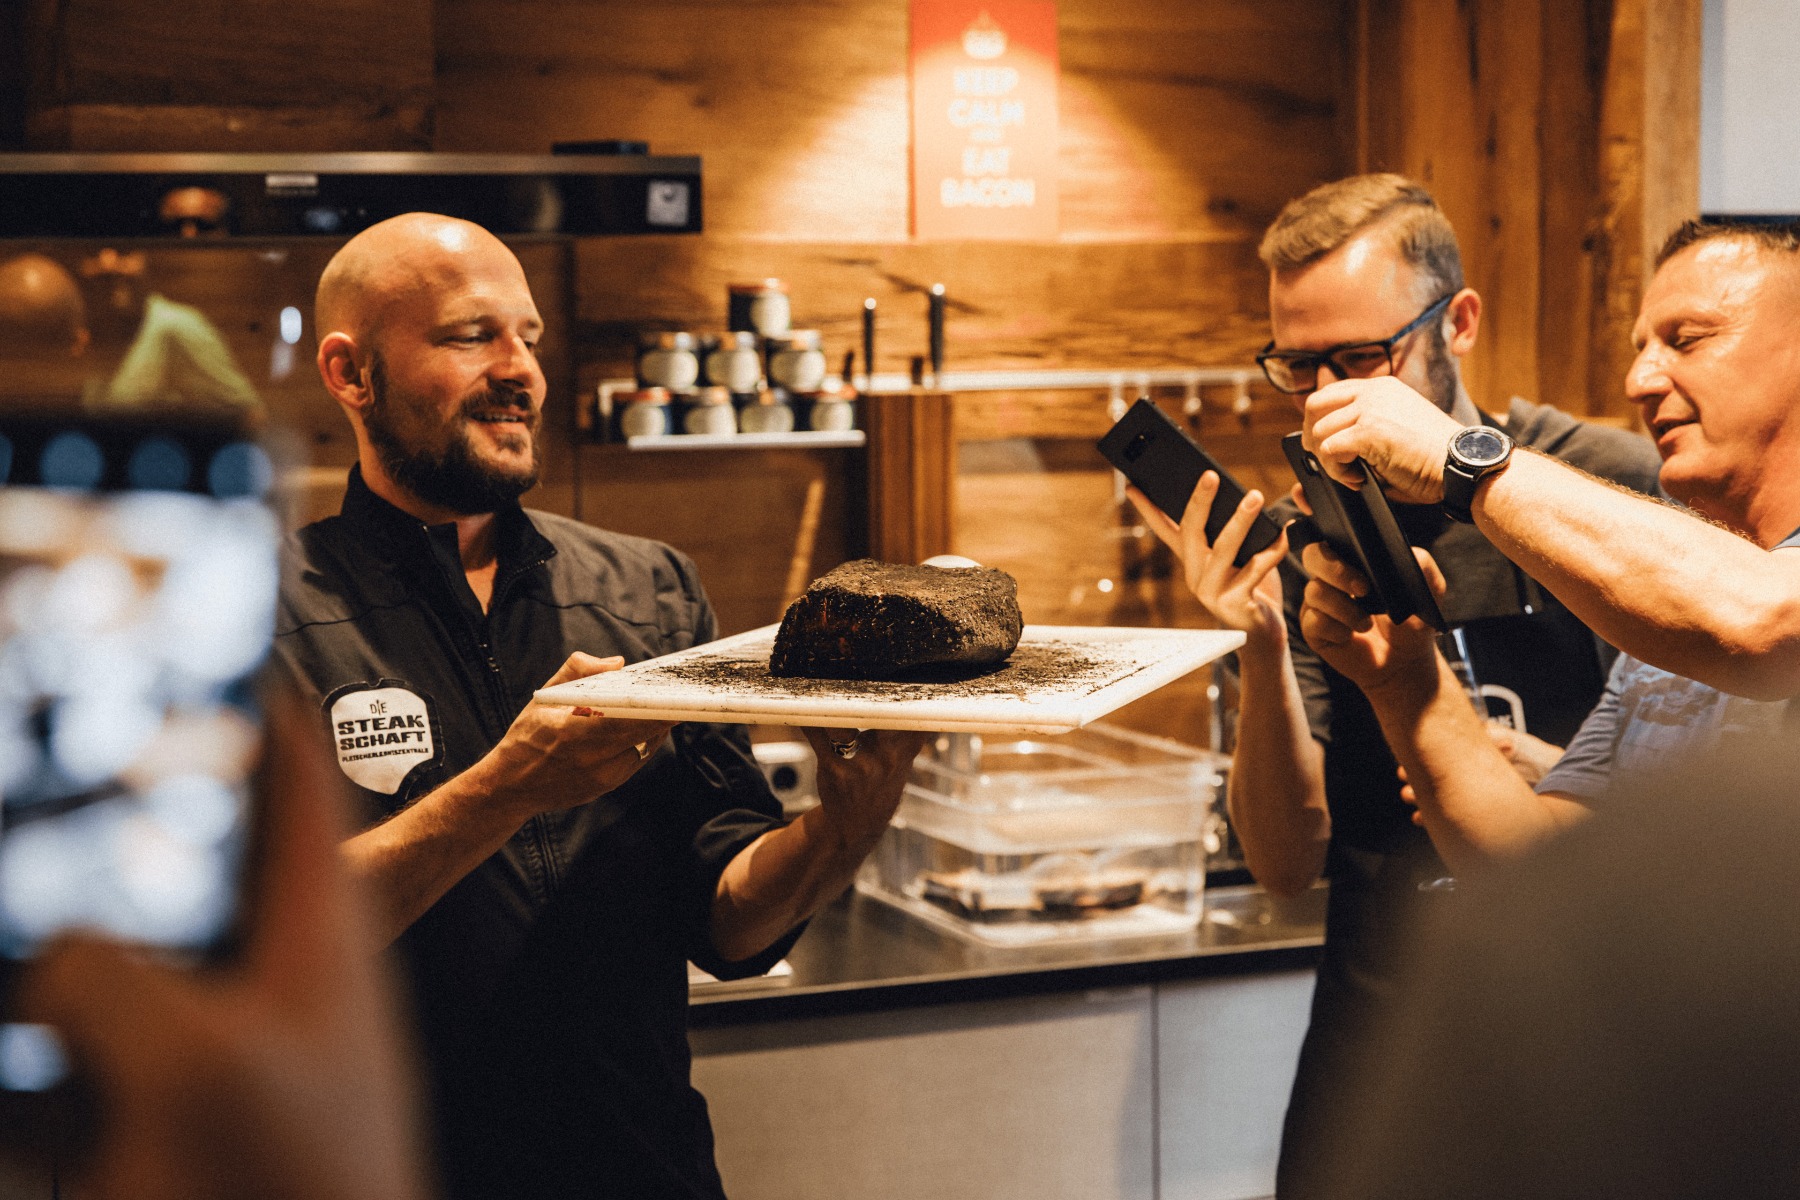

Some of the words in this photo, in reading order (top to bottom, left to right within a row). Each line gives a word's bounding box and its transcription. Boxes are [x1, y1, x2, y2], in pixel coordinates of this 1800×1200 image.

[948, 99, 1025, 127] CALM
[940, 178, 1035, 208] BACON
[369, 699, 388, 716] DIE
[337, 714, 425, 736] STEAK
[340, 730, 426, 751] SCHAFT
